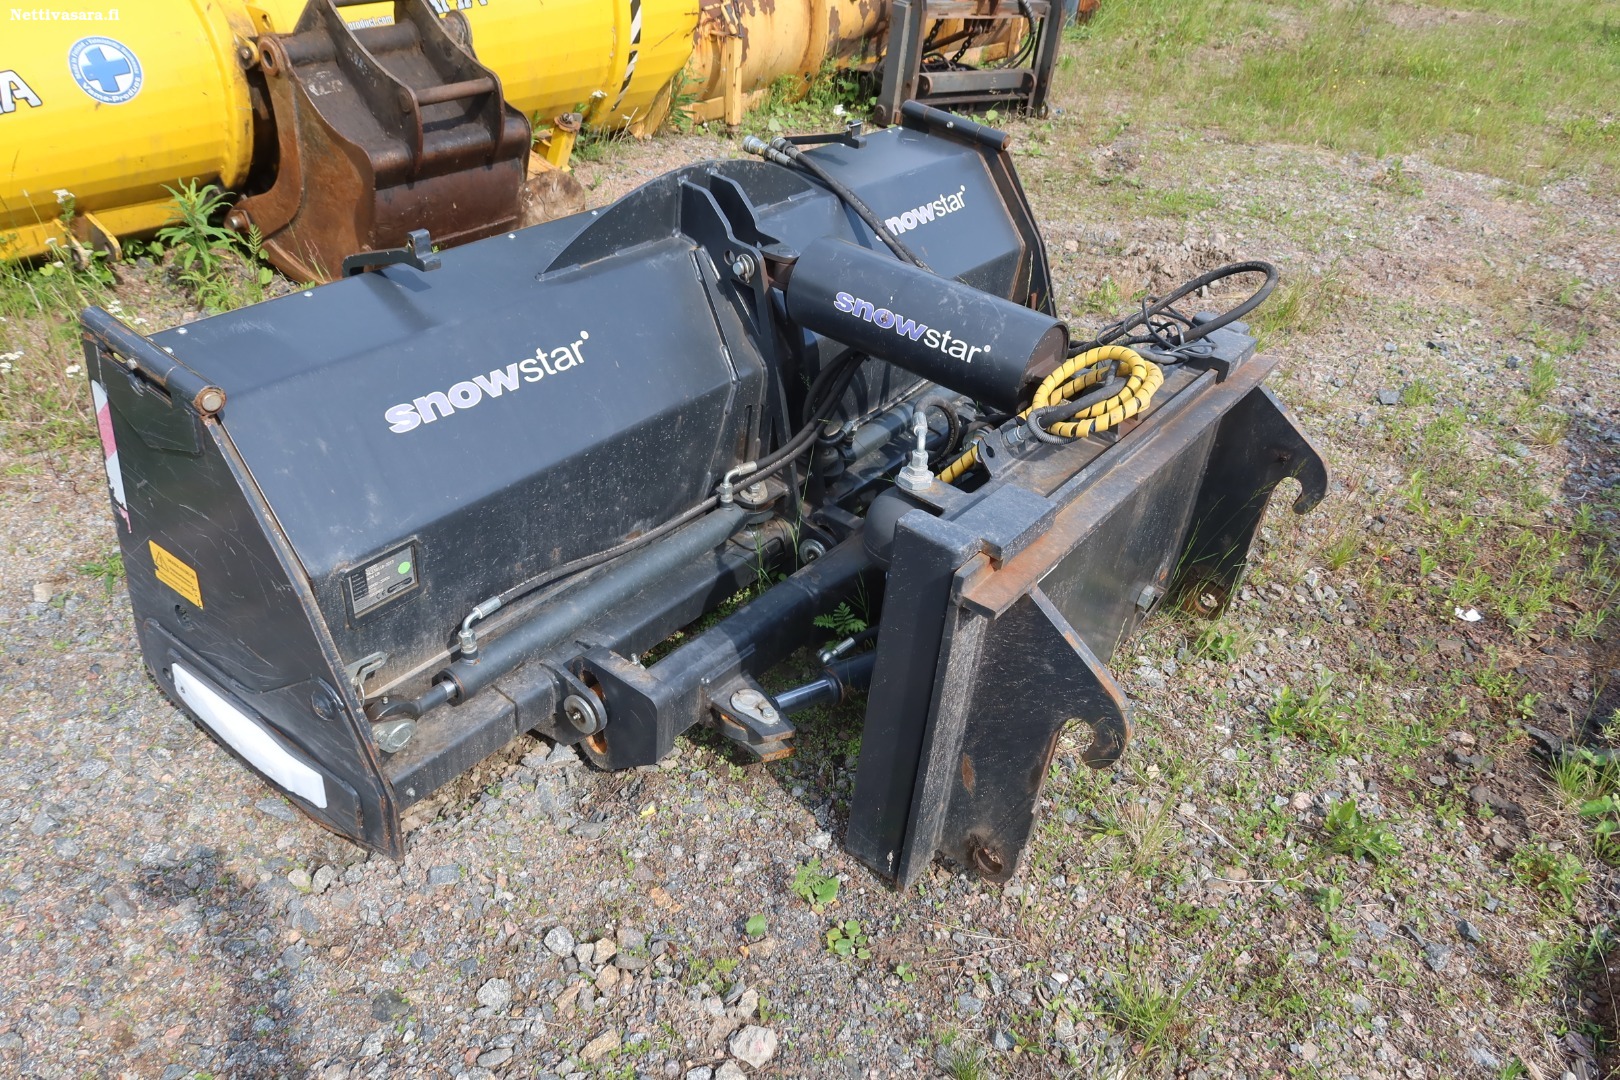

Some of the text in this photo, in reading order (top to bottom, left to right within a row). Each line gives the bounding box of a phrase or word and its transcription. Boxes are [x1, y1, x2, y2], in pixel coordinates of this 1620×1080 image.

[0, 69, 43, 115] A
[876, 185, 966, 241] nowstar
[833, 291, 991, 364] snowstar
[384, 331, 589, 434] snowstar
